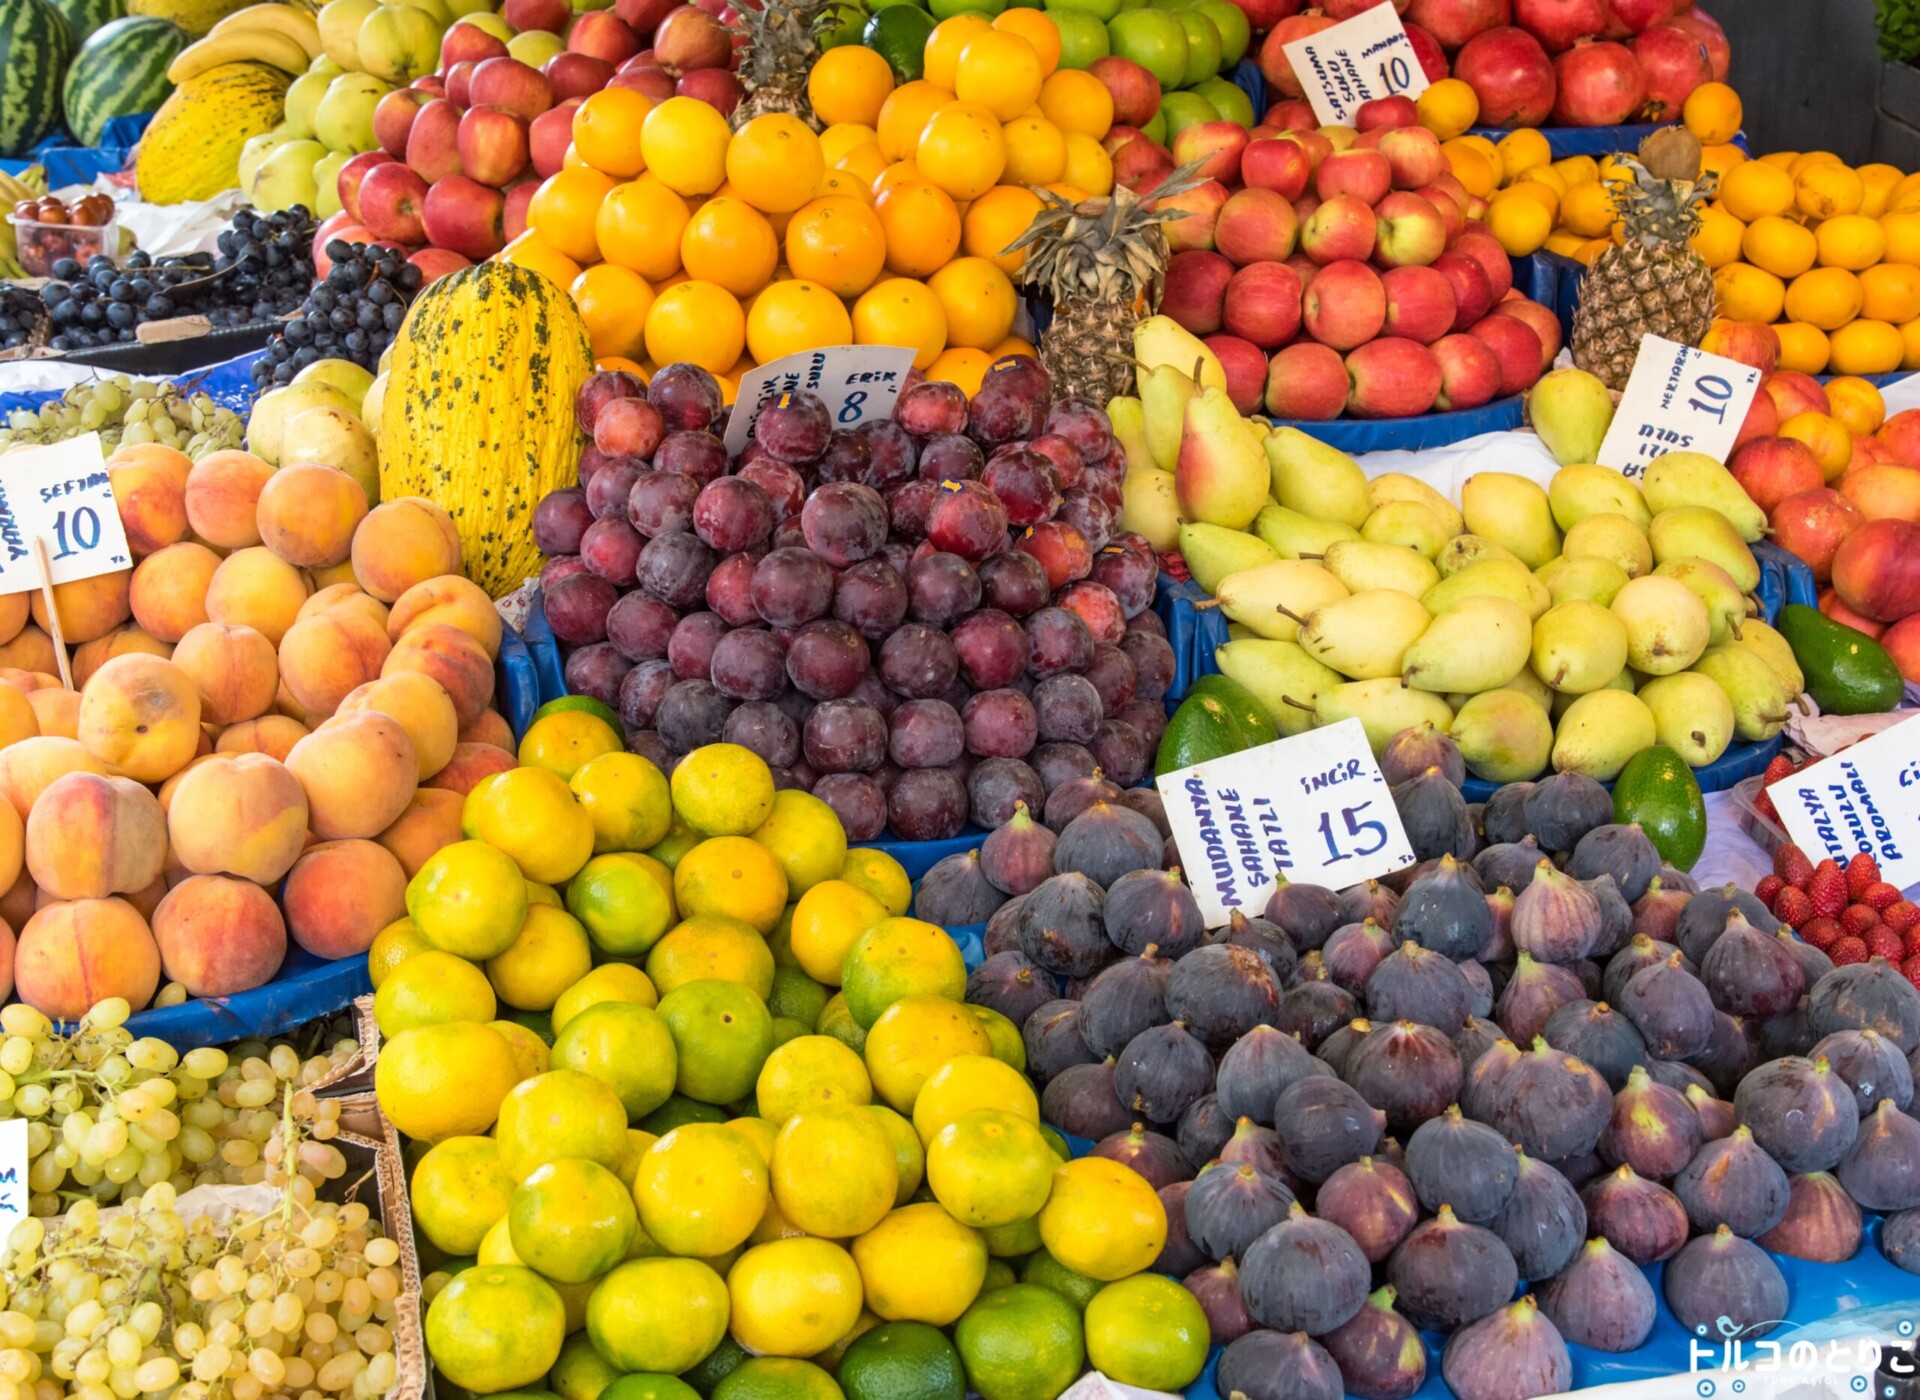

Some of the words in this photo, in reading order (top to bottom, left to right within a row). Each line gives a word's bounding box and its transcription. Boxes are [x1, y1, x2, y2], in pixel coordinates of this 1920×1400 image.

[1305, 46, 1347, 120] SATSUMA
[1327, 60, 1355, 102] SULU
[1335, 48, 1373, 100] AHANE
[1379, 57, 1410, 95] 10
[806, 352, 826, 390] SULU
[838, 391, 867, 423] 8
[1688, 375, 1733, 424] 10
[1637, 423, 1694, 448] SULU
[53, 506, 101, 561] 10
[1252, 798, 1294, 872] TATLI
[1318, 800, 1388, 866] 15
[1828, 785, 1882, 868] OKULU
[1840, 762, 1903, 860] AROMALI
[1184, 777, 1243, 907] MUDANYA
